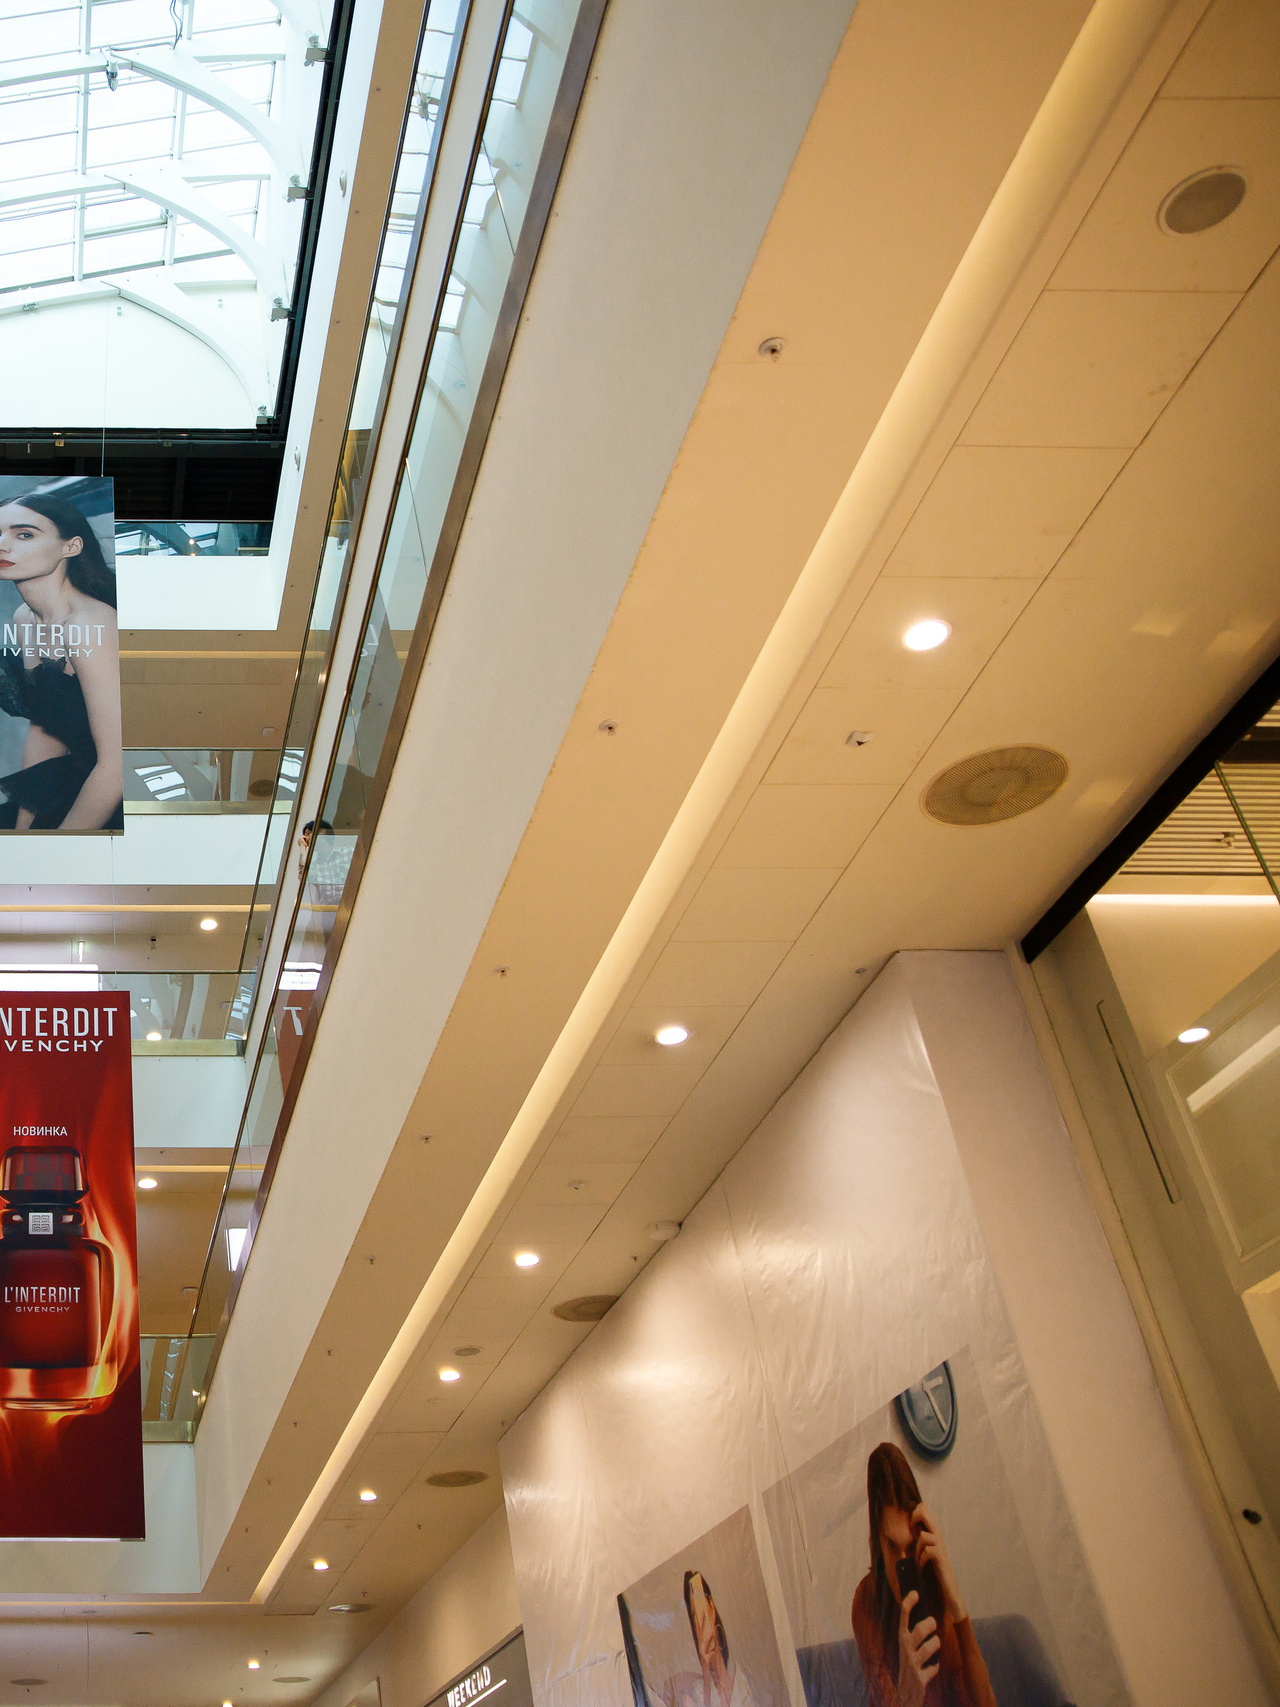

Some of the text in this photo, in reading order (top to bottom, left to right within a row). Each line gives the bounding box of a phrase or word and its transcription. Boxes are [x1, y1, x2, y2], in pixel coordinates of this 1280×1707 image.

[13, 1126, 68, 1136] НОВИНКА
[4, 1286, 81, 1304] L'INTERDIT
[447, 1665, 491, 1707] WEEKEND
